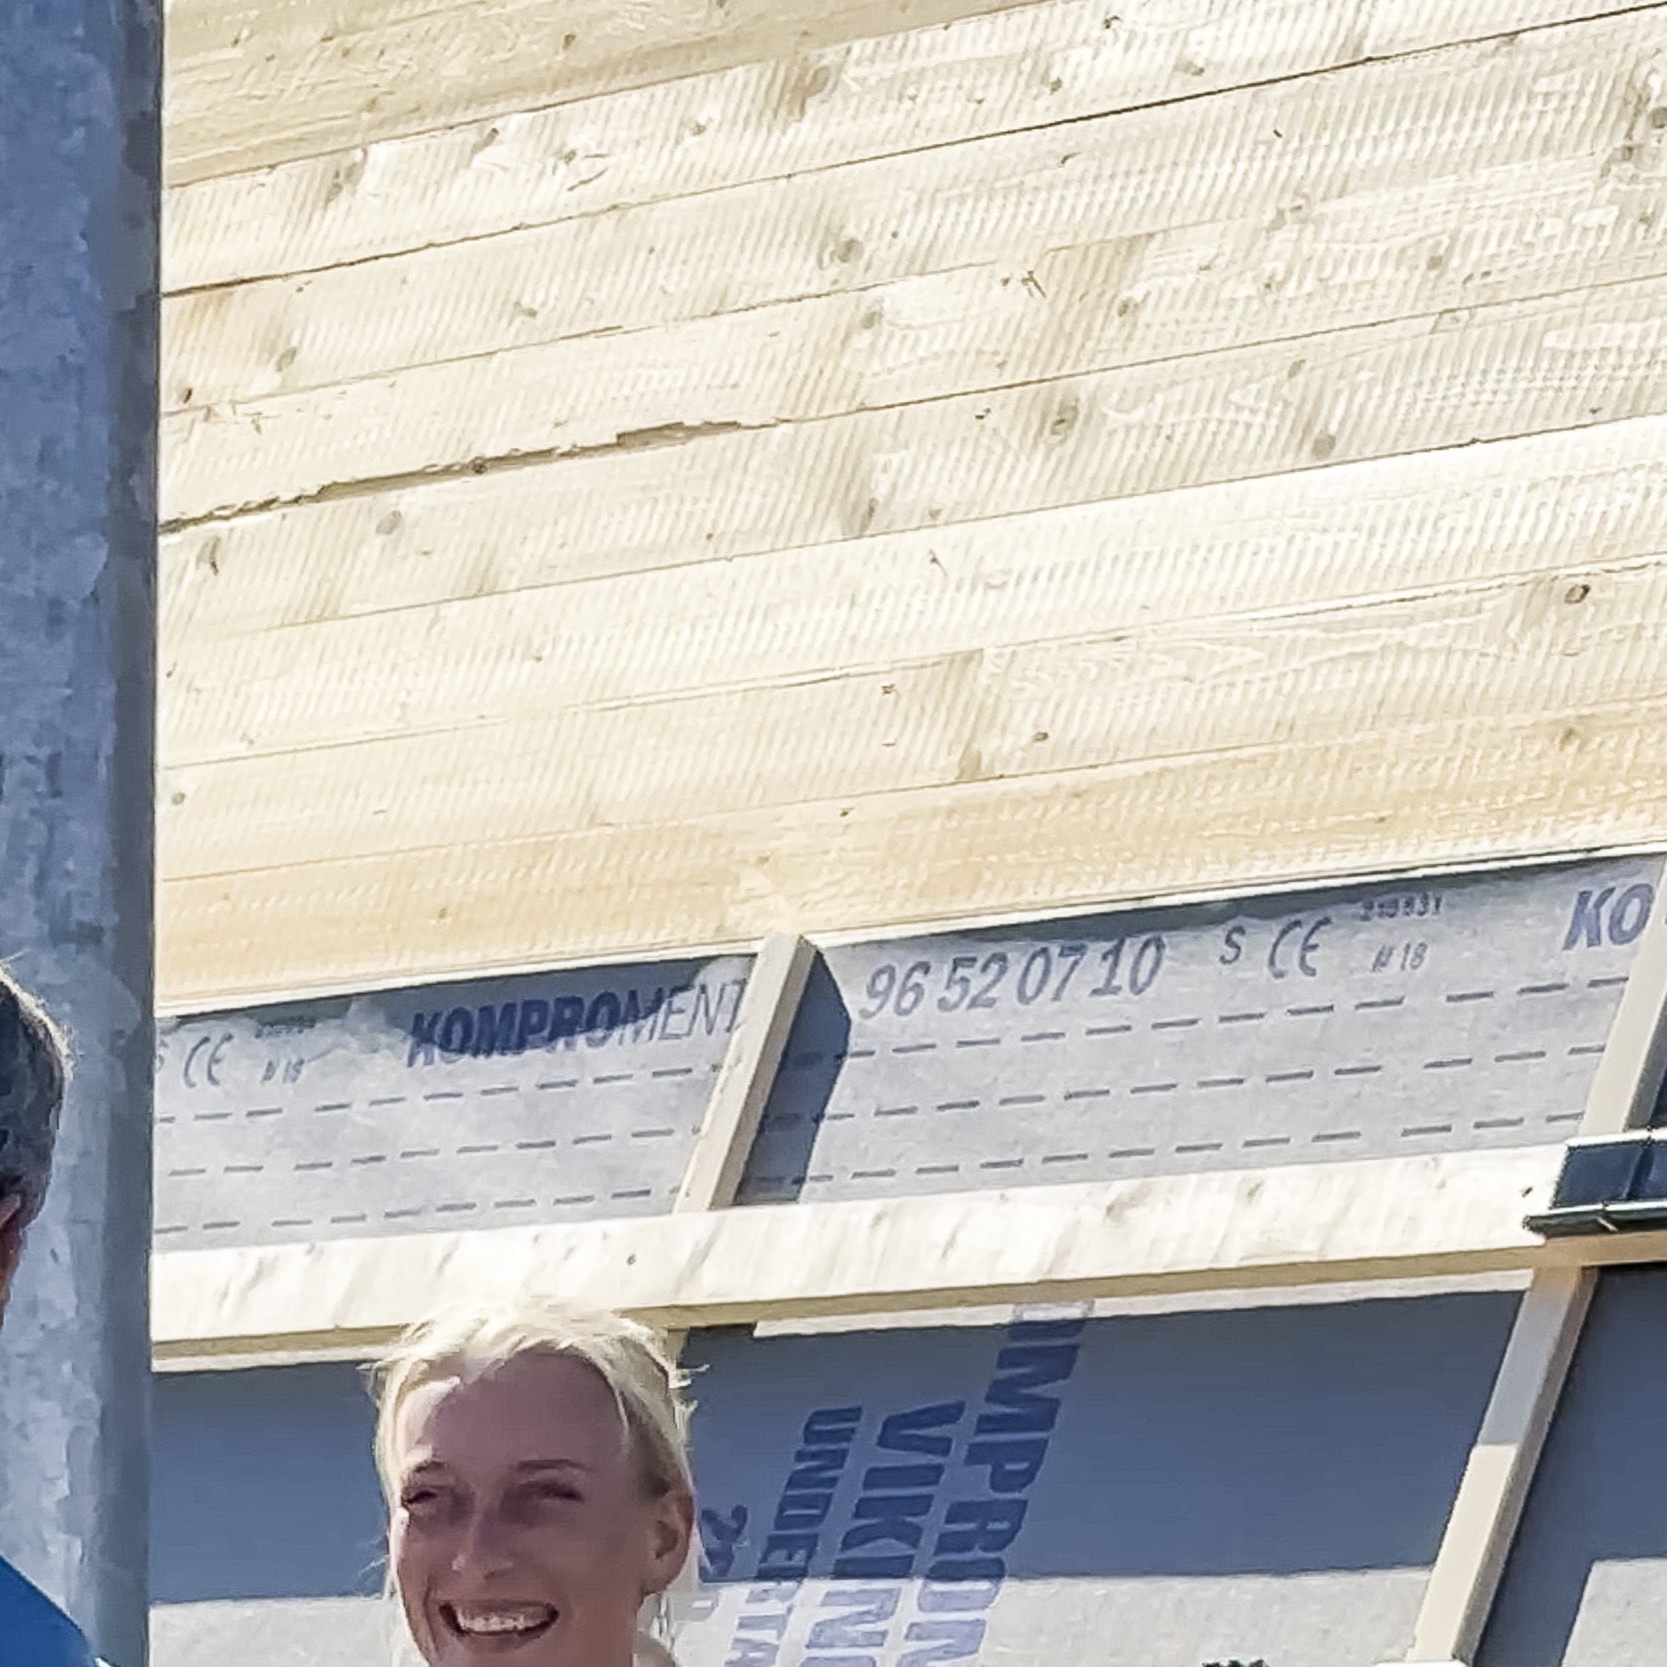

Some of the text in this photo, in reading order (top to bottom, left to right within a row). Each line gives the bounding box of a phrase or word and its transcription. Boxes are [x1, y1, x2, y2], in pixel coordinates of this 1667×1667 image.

[1562, 883, 1655, 951] KO
[858, 960, 931, 1020] 96
[937, 951, 1010, 1012] 52
[1017, 942, 1087, 1007] 07
[1089, 934, 1166, 998] 10
[407, 976, 747, 1069] KOMPROMENT
